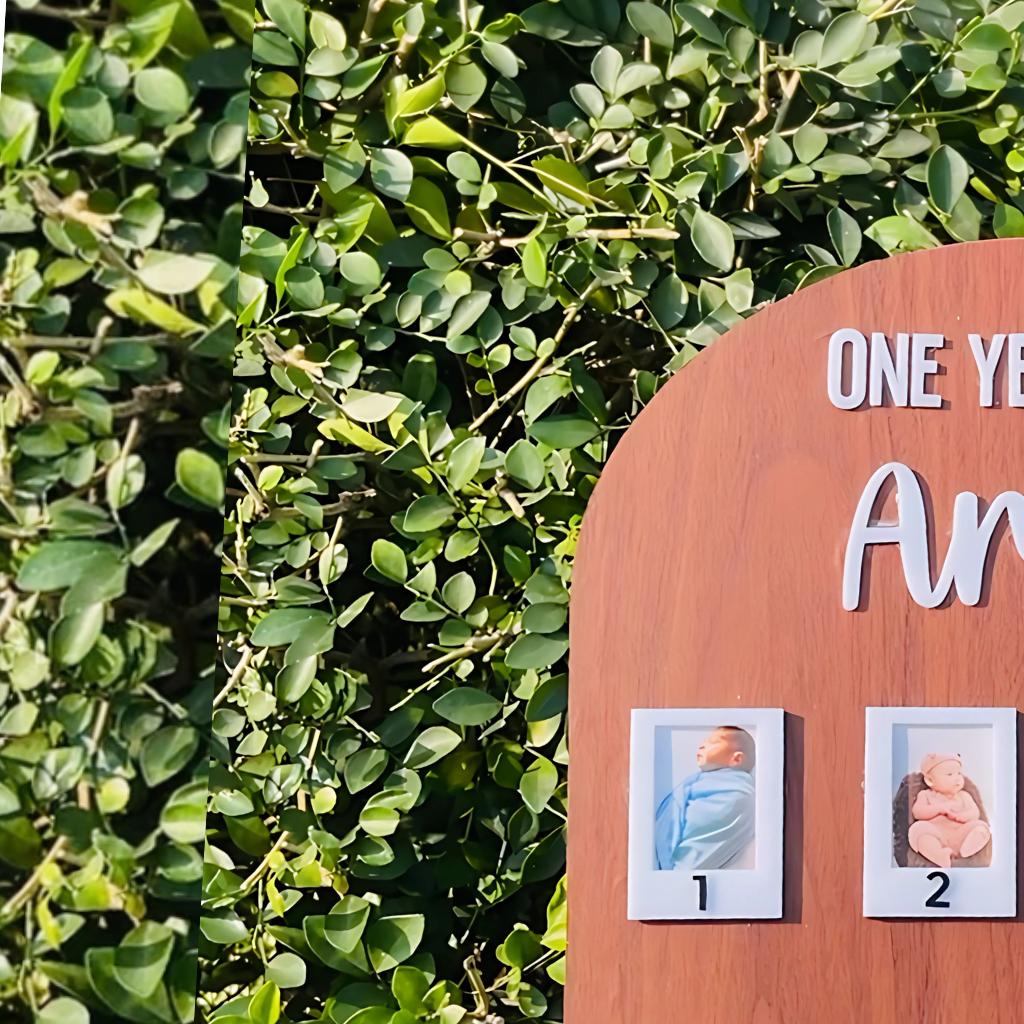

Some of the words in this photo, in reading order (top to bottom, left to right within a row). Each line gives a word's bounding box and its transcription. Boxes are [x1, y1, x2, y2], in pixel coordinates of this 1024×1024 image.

[827, 328, 945, 410] ONE
[692, 875, 708, 911] 1
[925, 871, 951, 909] 2
